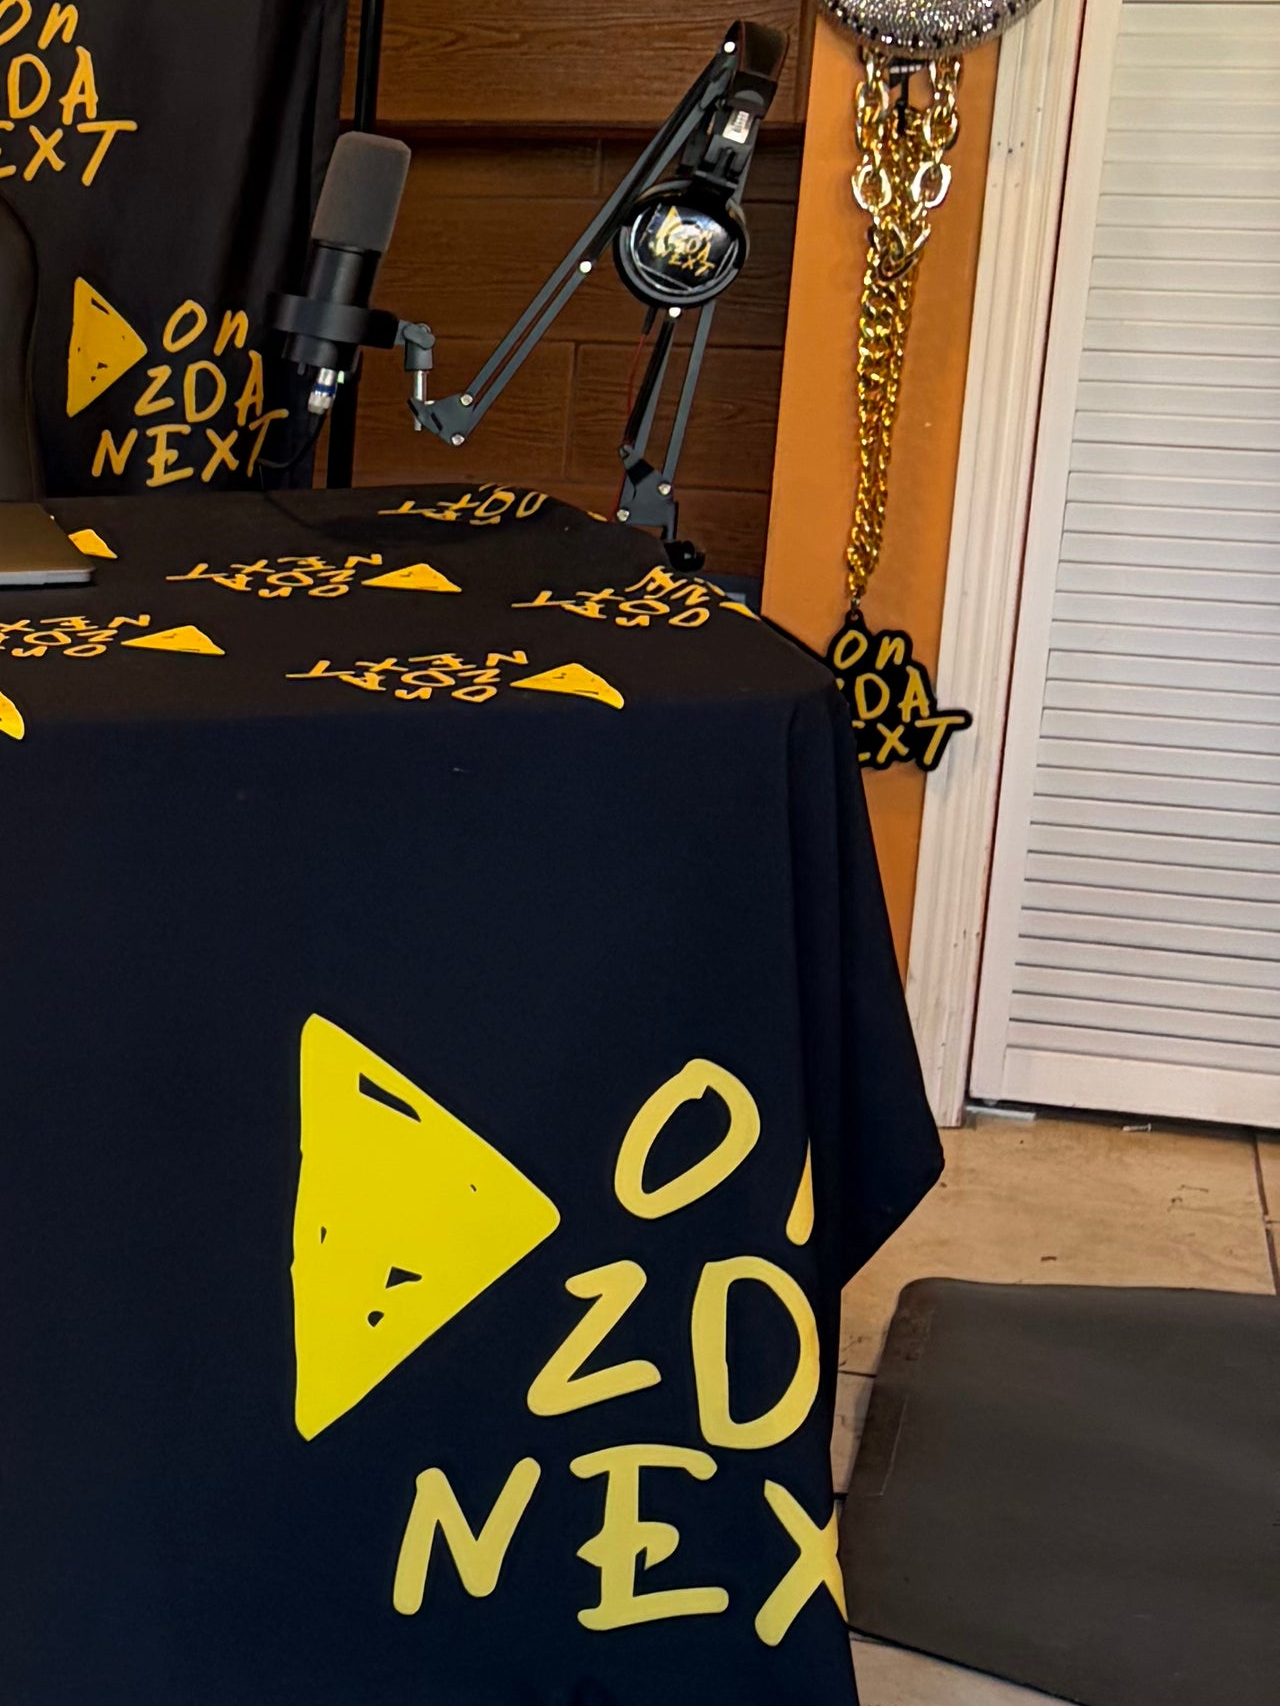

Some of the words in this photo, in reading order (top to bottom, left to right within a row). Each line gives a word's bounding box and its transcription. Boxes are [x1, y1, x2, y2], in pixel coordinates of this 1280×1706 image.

[162, 299, 249, 356] On
[91, 408, 289, 488] NEXT
[833, 629, 905, 670] On
[836, 665, 930, 723] DA
[614, 1057, 815, 1246] O
[392, 1443, 850, 1647] NEX
